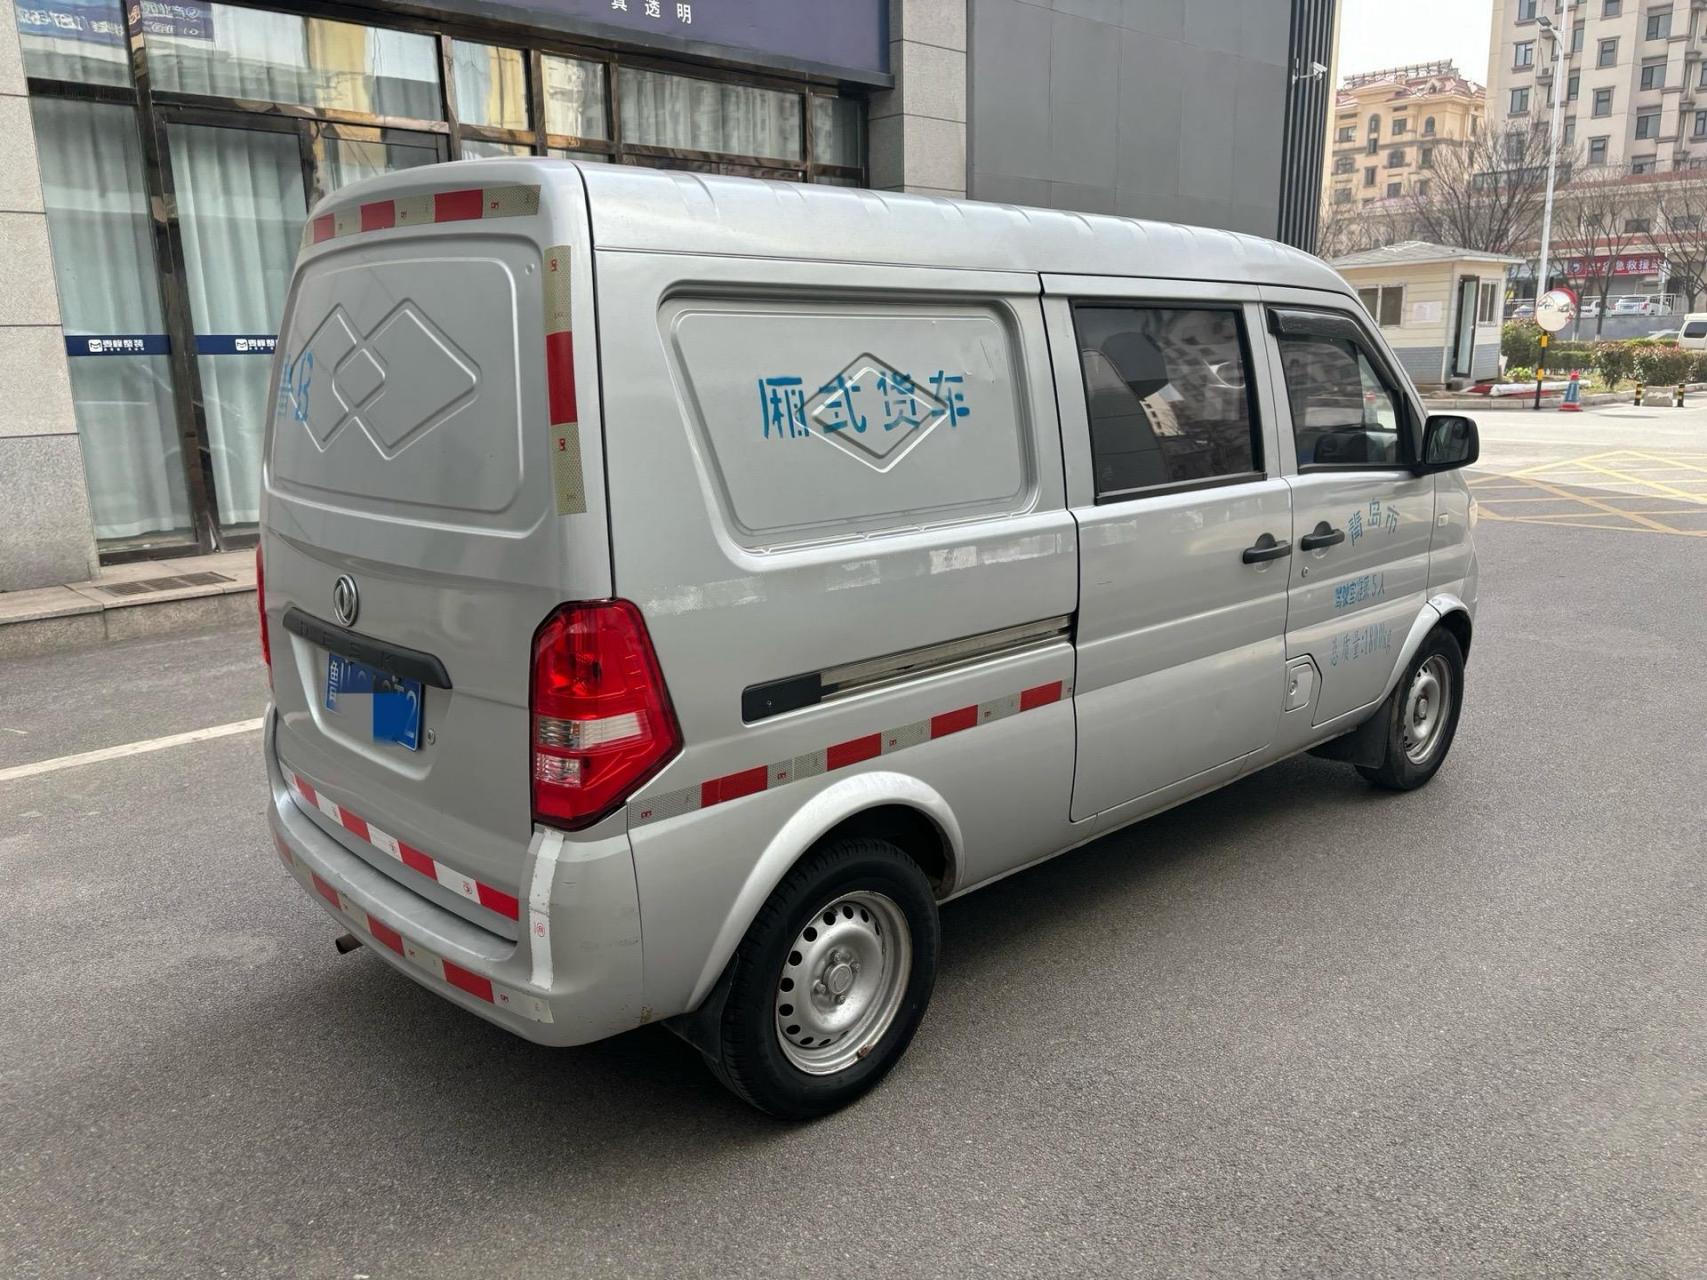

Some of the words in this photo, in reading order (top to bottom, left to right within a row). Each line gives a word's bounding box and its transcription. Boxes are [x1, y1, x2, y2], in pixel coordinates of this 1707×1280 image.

[758, 370, 971, 439] 厢式货车
[1348, 498, 1400, 547] 青岛市
